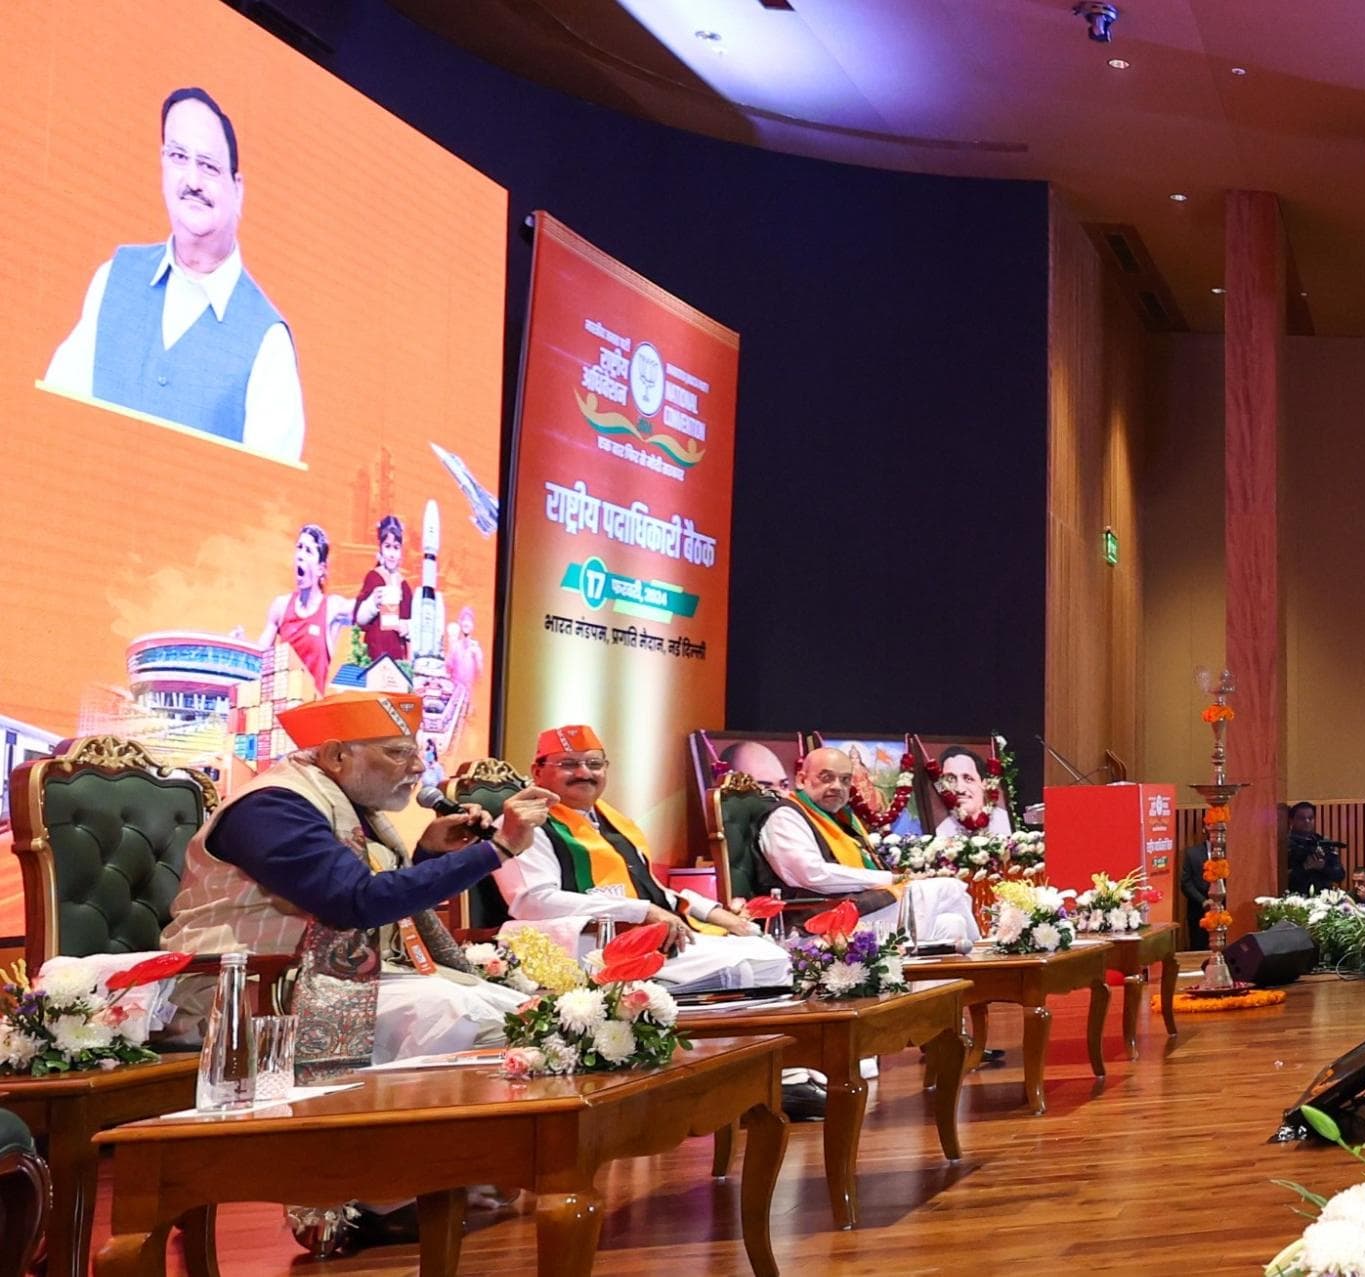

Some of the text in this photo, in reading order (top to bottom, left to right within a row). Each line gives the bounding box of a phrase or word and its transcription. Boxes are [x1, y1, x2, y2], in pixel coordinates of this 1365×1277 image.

[545, 480, 717, 568] राष्ट्रीय पदाधिकारी बैठक
[586, 568, 606, 599] 17
[544, 613, 573, 636] भारत
